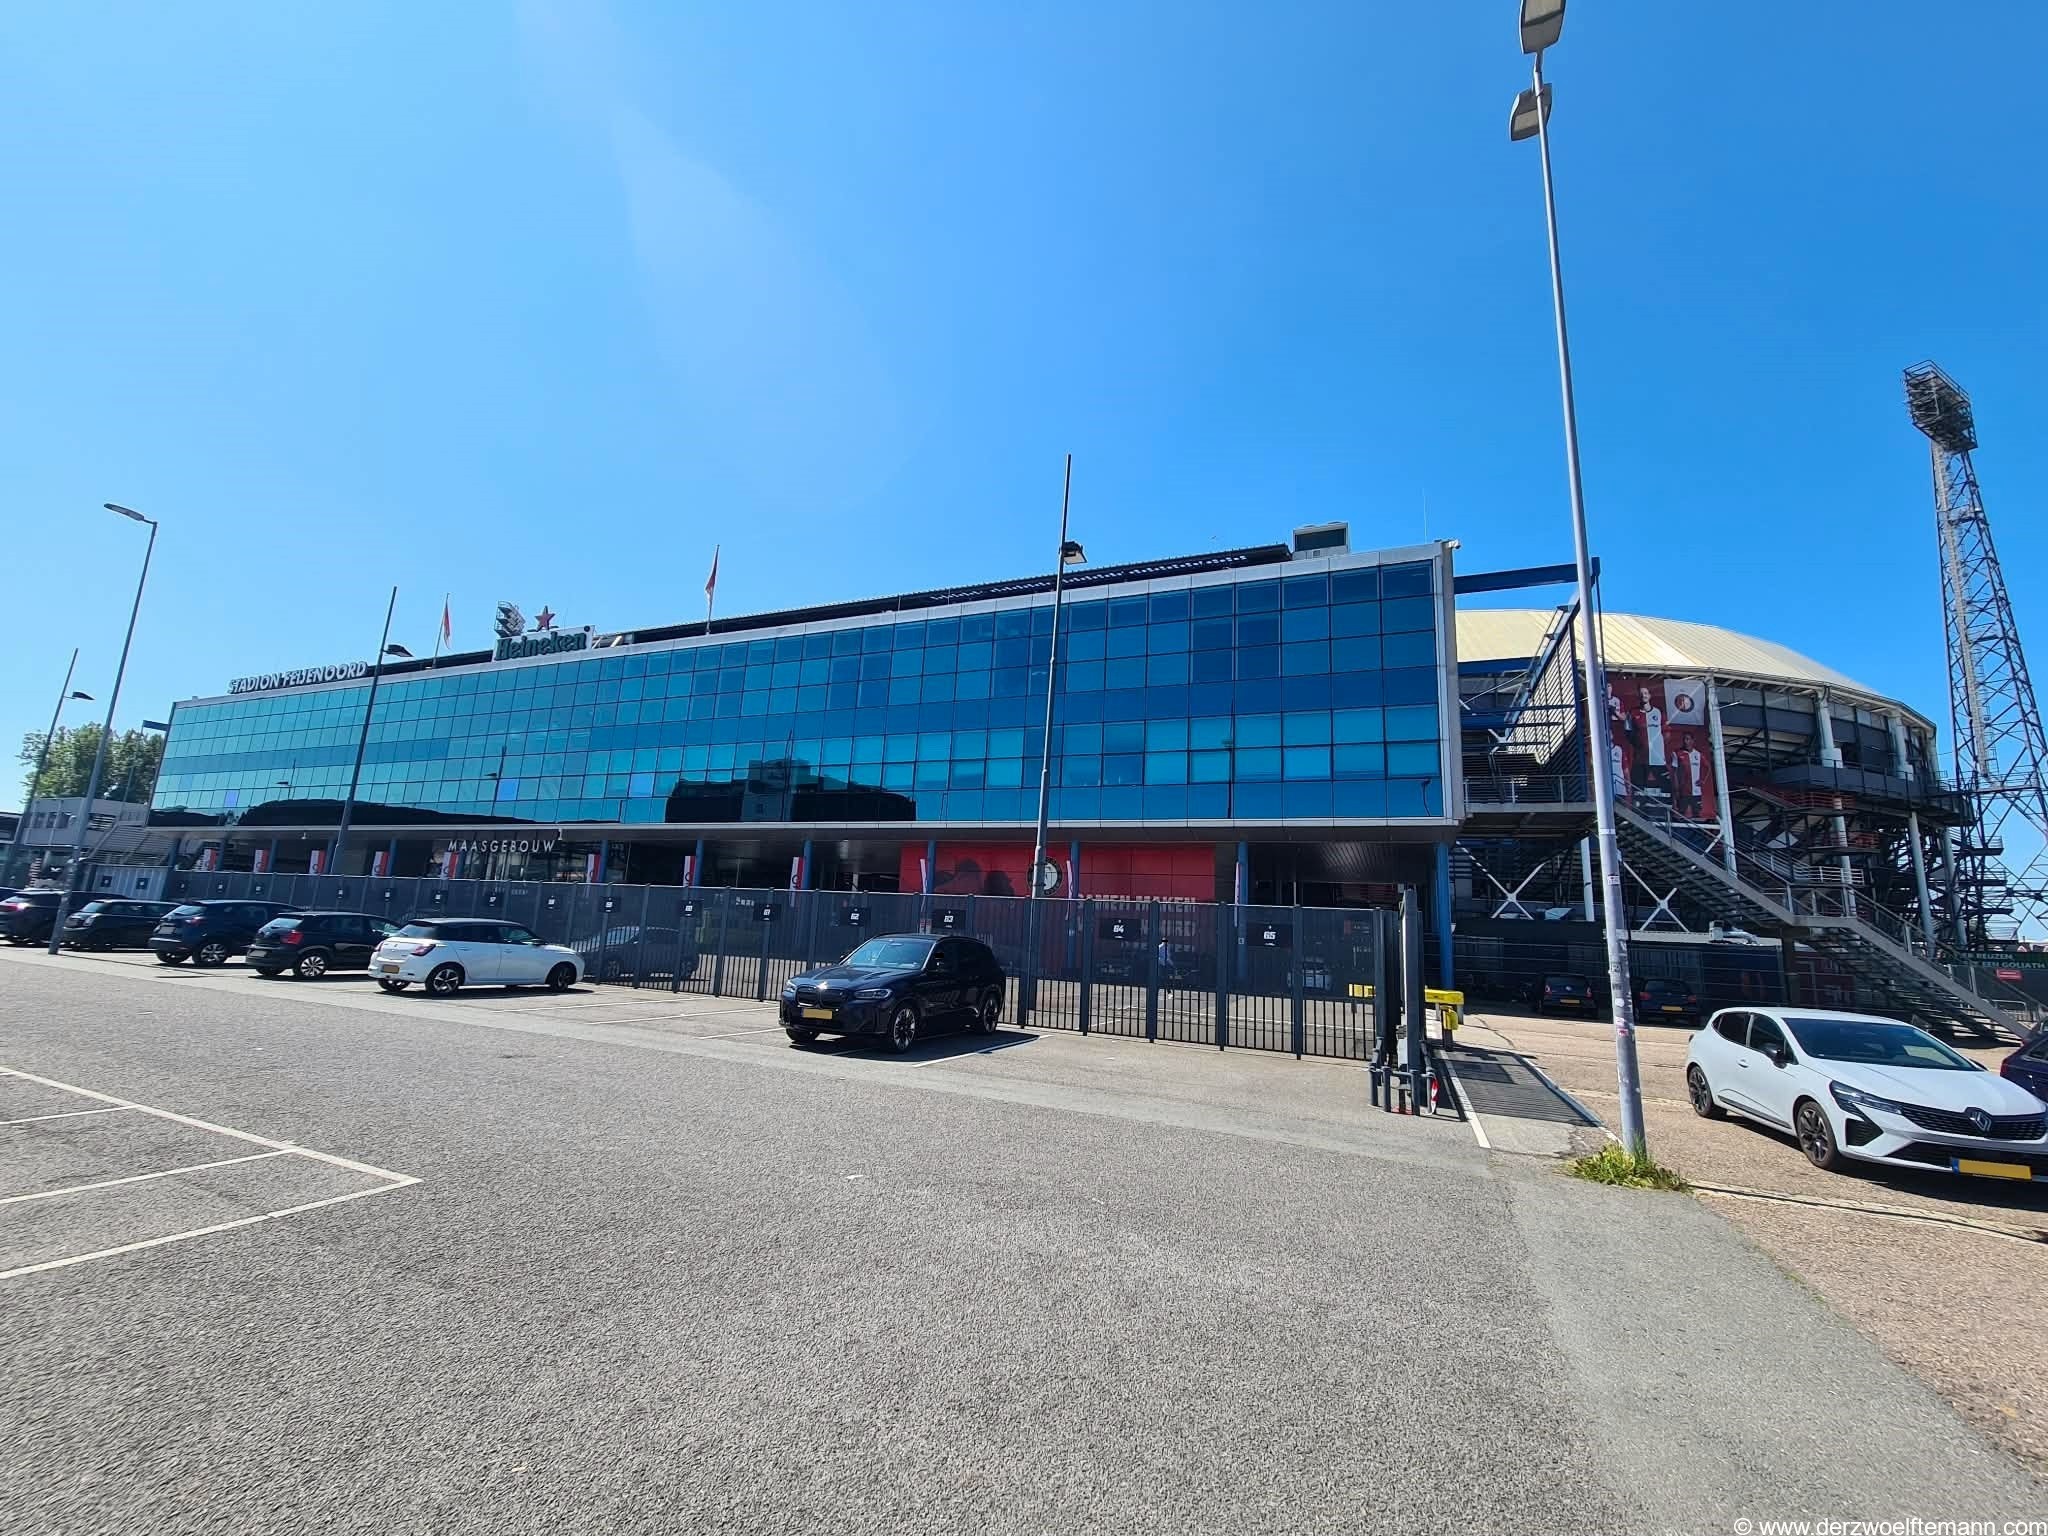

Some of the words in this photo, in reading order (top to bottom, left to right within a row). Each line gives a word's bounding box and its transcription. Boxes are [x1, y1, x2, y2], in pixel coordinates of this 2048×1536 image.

[494, 631, 588, 660] Heineken
[228, 671, 282, 694] STADION
[281, 661, 368, 688] FEIJENOORD
[448, 839, 556, 853] MAASGEBOUW
[1112, 924, 1125, 934] 64
[1263, 931, 1277, 940] 65
